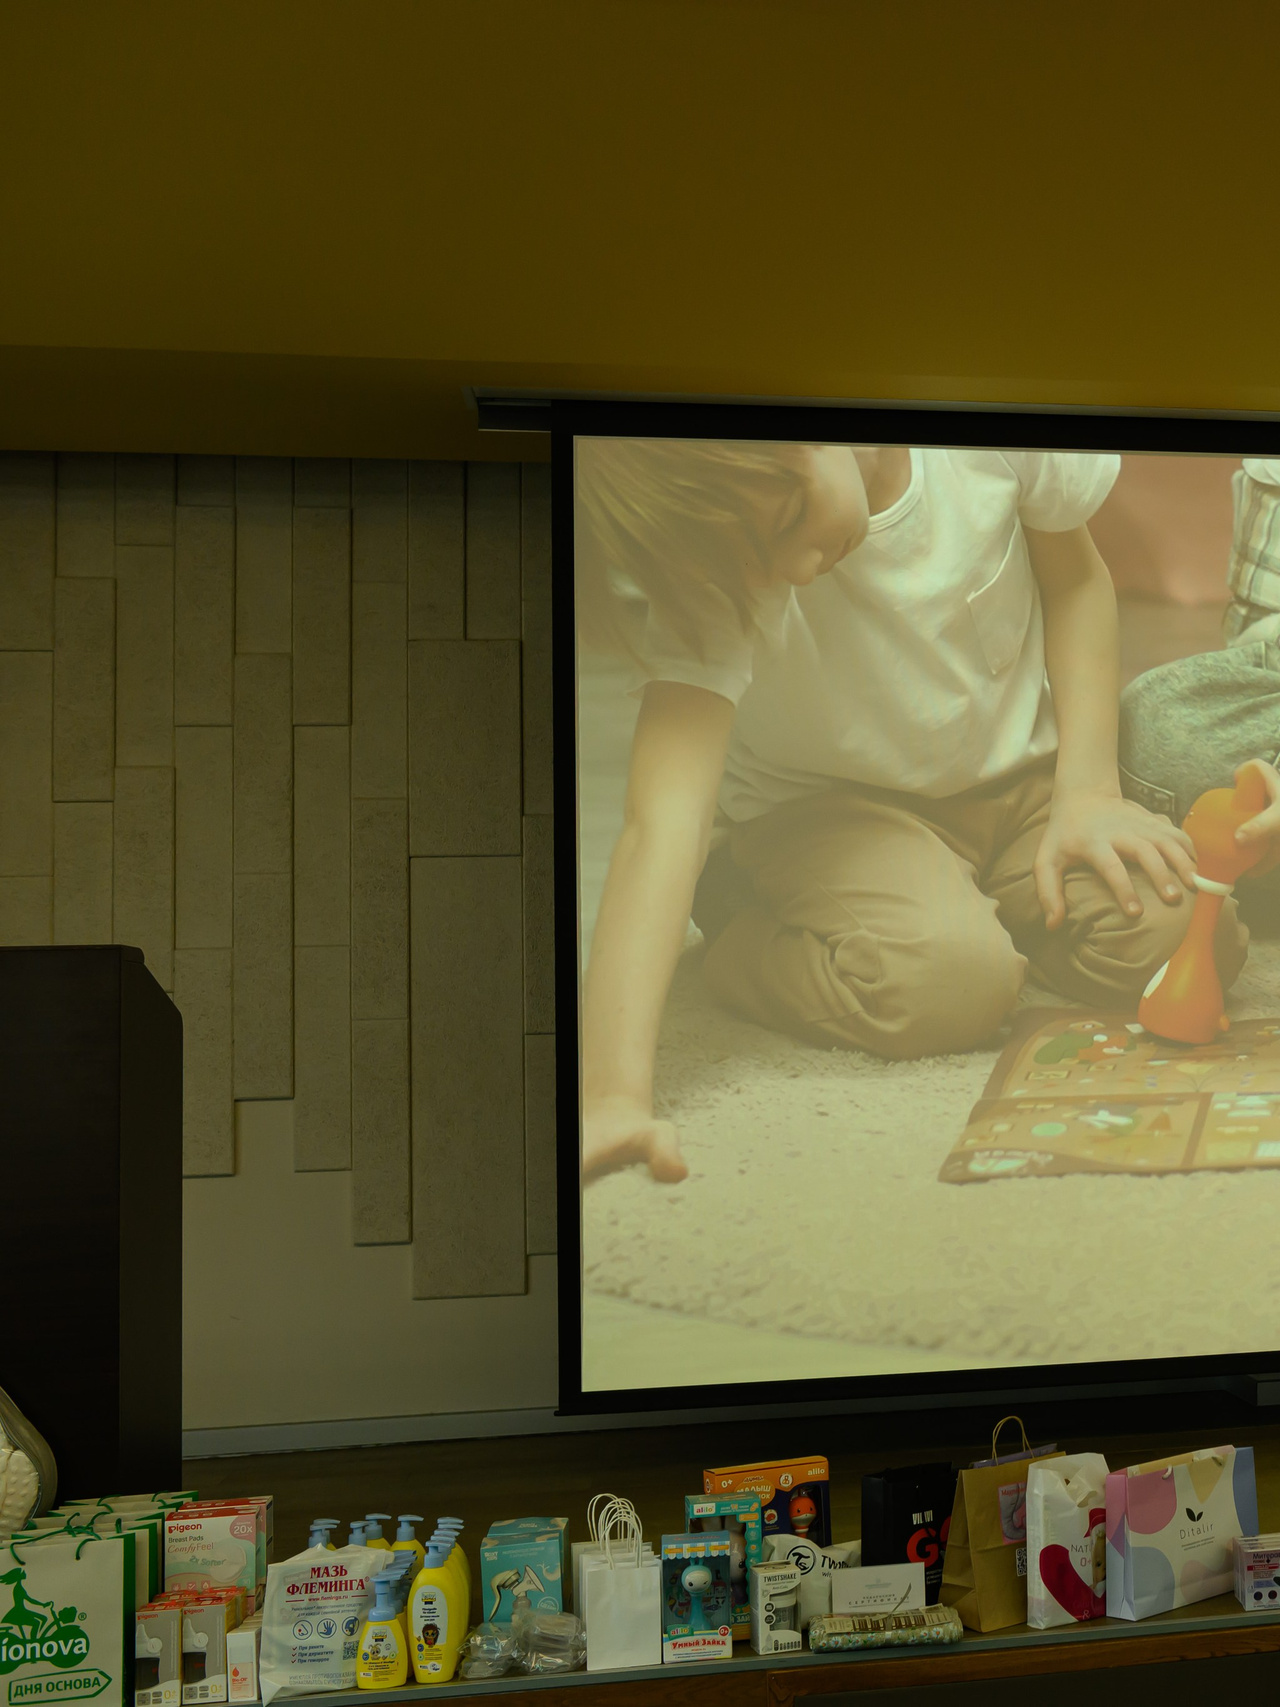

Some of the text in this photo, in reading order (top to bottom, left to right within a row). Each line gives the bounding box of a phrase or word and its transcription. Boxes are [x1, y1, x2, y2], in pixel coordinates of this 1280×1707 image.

[808, 1468, 825, 1476] alilo
[721, 1479, 733, 1488] 0+
[696, 1506, 713, 1514] alilo
[1070, 1544, 1091, 1553] NAT
[310, 1565, 348, 1578] МАЗЬ
[286, 1579, 366, 1595] ФЛЕМИНГА
[0, 1637, 88, 1662] ionova
[14, 1677, 101, 1698] ДНЯ ОСНОВА
